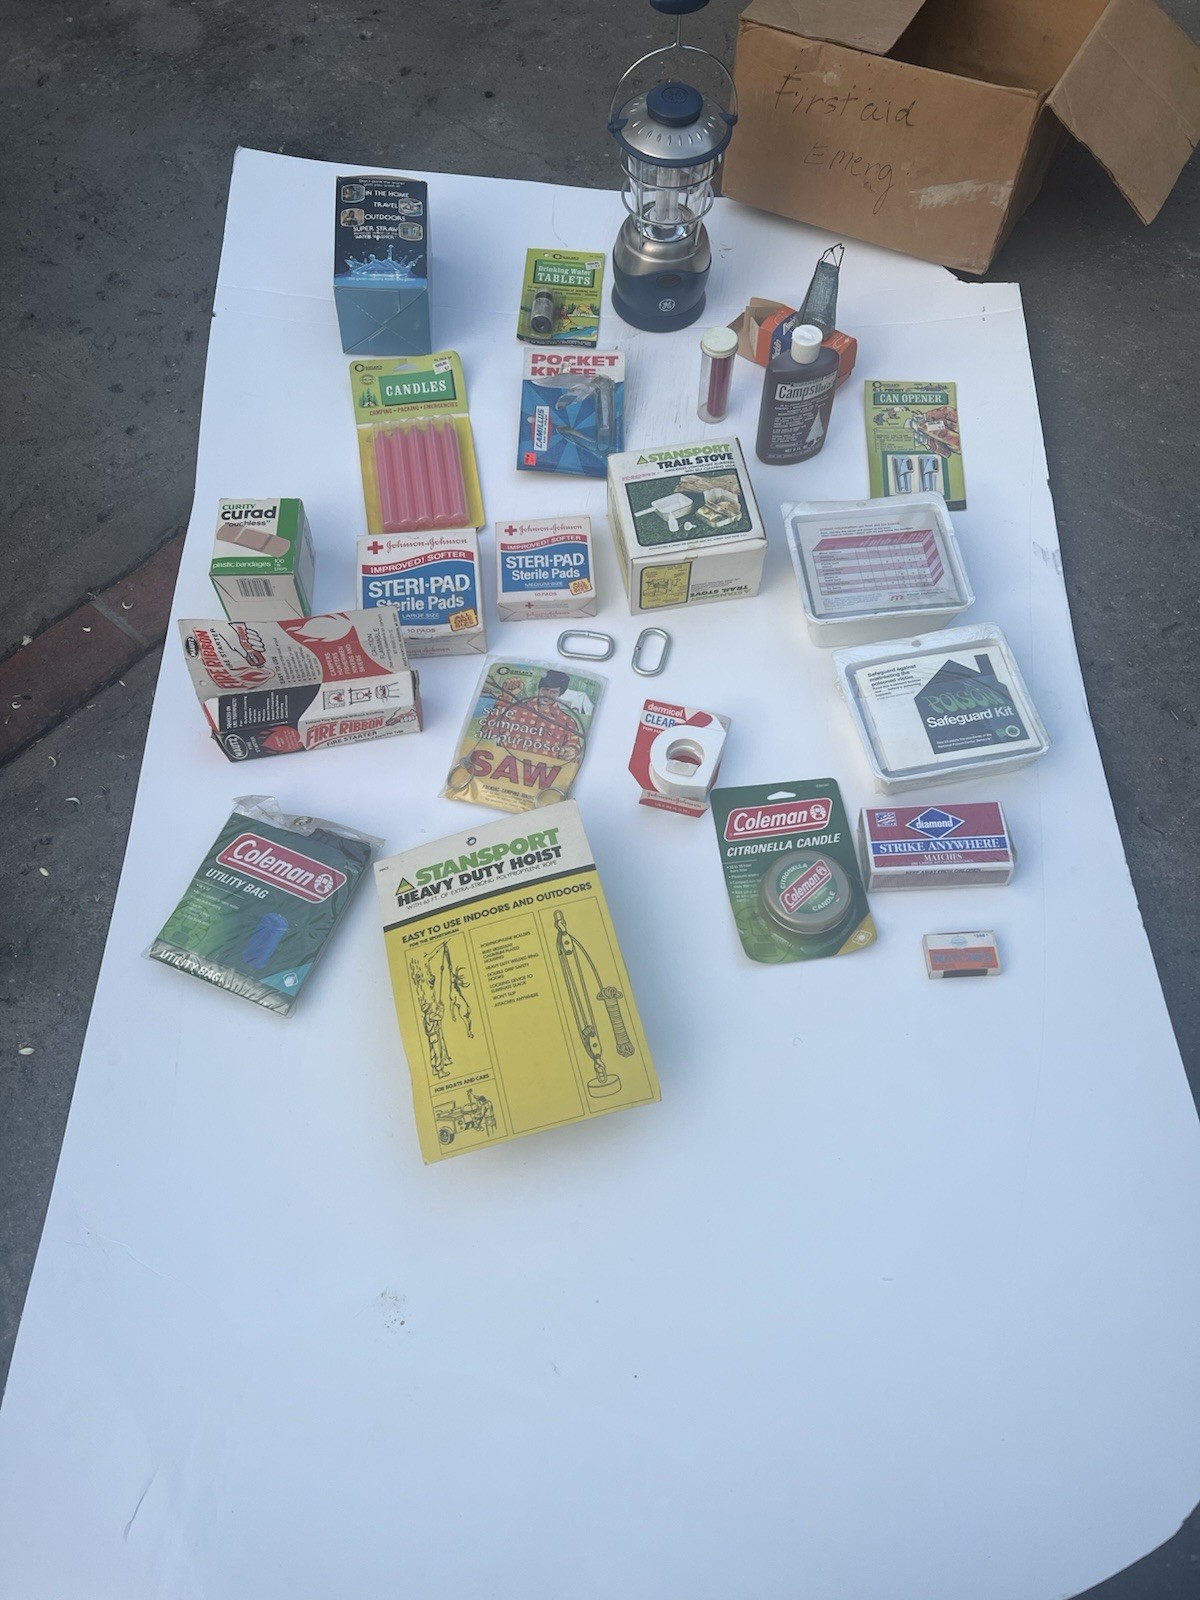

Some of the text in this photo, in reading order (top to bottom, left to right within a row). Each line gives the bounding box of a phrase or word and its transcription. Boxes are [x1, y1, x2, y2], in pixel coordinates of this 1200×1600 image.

[775, 74, 916, 127] First aid
[538, 266, 569, 274] Drinking
[537, 273, 591, 285] TABLETS
[531, 366, 597, 378] KNFE
[385, 380, 447, 397] CANDLES
[880, 394, 942, 403] CAN OPENER
[369, 402, 458, 416] CAMPING PACKING EMERGENCIES
[648, 444, 732, 462] STANSPORT
[657, 458, 692, 470] TRAIL
[695, 452, 734, 464] STOVE
[221, 506, 277, 520] curad
[386, 540, 424, 553] Johnson
[429, 537, 467, 550] Johnson
[507, 535, 581, 550] IMPROVED! SOFTER
[213, 560, 271, 569] plastic bandages
[371, 551, 466, 573] IMPROVED! SOFTER
[511, 568, 580, 581] Sterile Pads
[690, 589, 720, 597] STOVE
[722, 585, 748, 593] TRAIL
[427, 594, 465, 611] Pads
[195, 629, 223, 667] RIBBON
[210, 628, 226, 658] STARTER
[367, 633, 378, 656] CAUTION
[868, 668, 896, 677] Safeguard
[871, 678, 897, 687] poisoned
[483, 707, 514, 719] safe
[648, 703, 684, 717] dermicel
[927, 706, 1014, 728] Safeguard Kit
[478, 717, 543, 737] compact
[645, 713, 676, 728] CLEAR
[306, 722, 338, 748] FIRE
[340, 718, 385, 735] RIBBON
[327, 739, 341, 747] FIRE
[344, 732, 377, 740] STARTER
[467, 750, 562, 790] SAW
[733, 810, 807, 832] Coleman
[916, 817, 953, 829] diamond
[727, 833, 841, 857] CITRONELLA CANDLE
[879, 839, 1000, 854] STRIKE ANYWHERE
[233, 839, 315, 886] Coleman
[415, 827, 559, 886] STANSPORT
[924, 853, 963, 861] MATCHES
[205, 868, 269, 899] UTILITY BAG
[397, 846, 561, 907] HEAVY DUTY HOIST
[781, 863, 808, 889] CITRONELLA
[406, 902, 421, 910] WITH
[451, 878, 494, 895] EXTRA-STRONG
[496, 865, 540, 880] POLYPROPYLENE
[784, 873, 820, 907] Coleman
[812, 891, 836, 912] CANDLE
[402, 882, 592, 944] EASY TO USE INDOORS AND OUTDOORS
[429, 928, 459, 940] SPORTSMAN
[159, 949, 199, 971] UTILITY
[445, 1081, 462, 1090] BOATS
